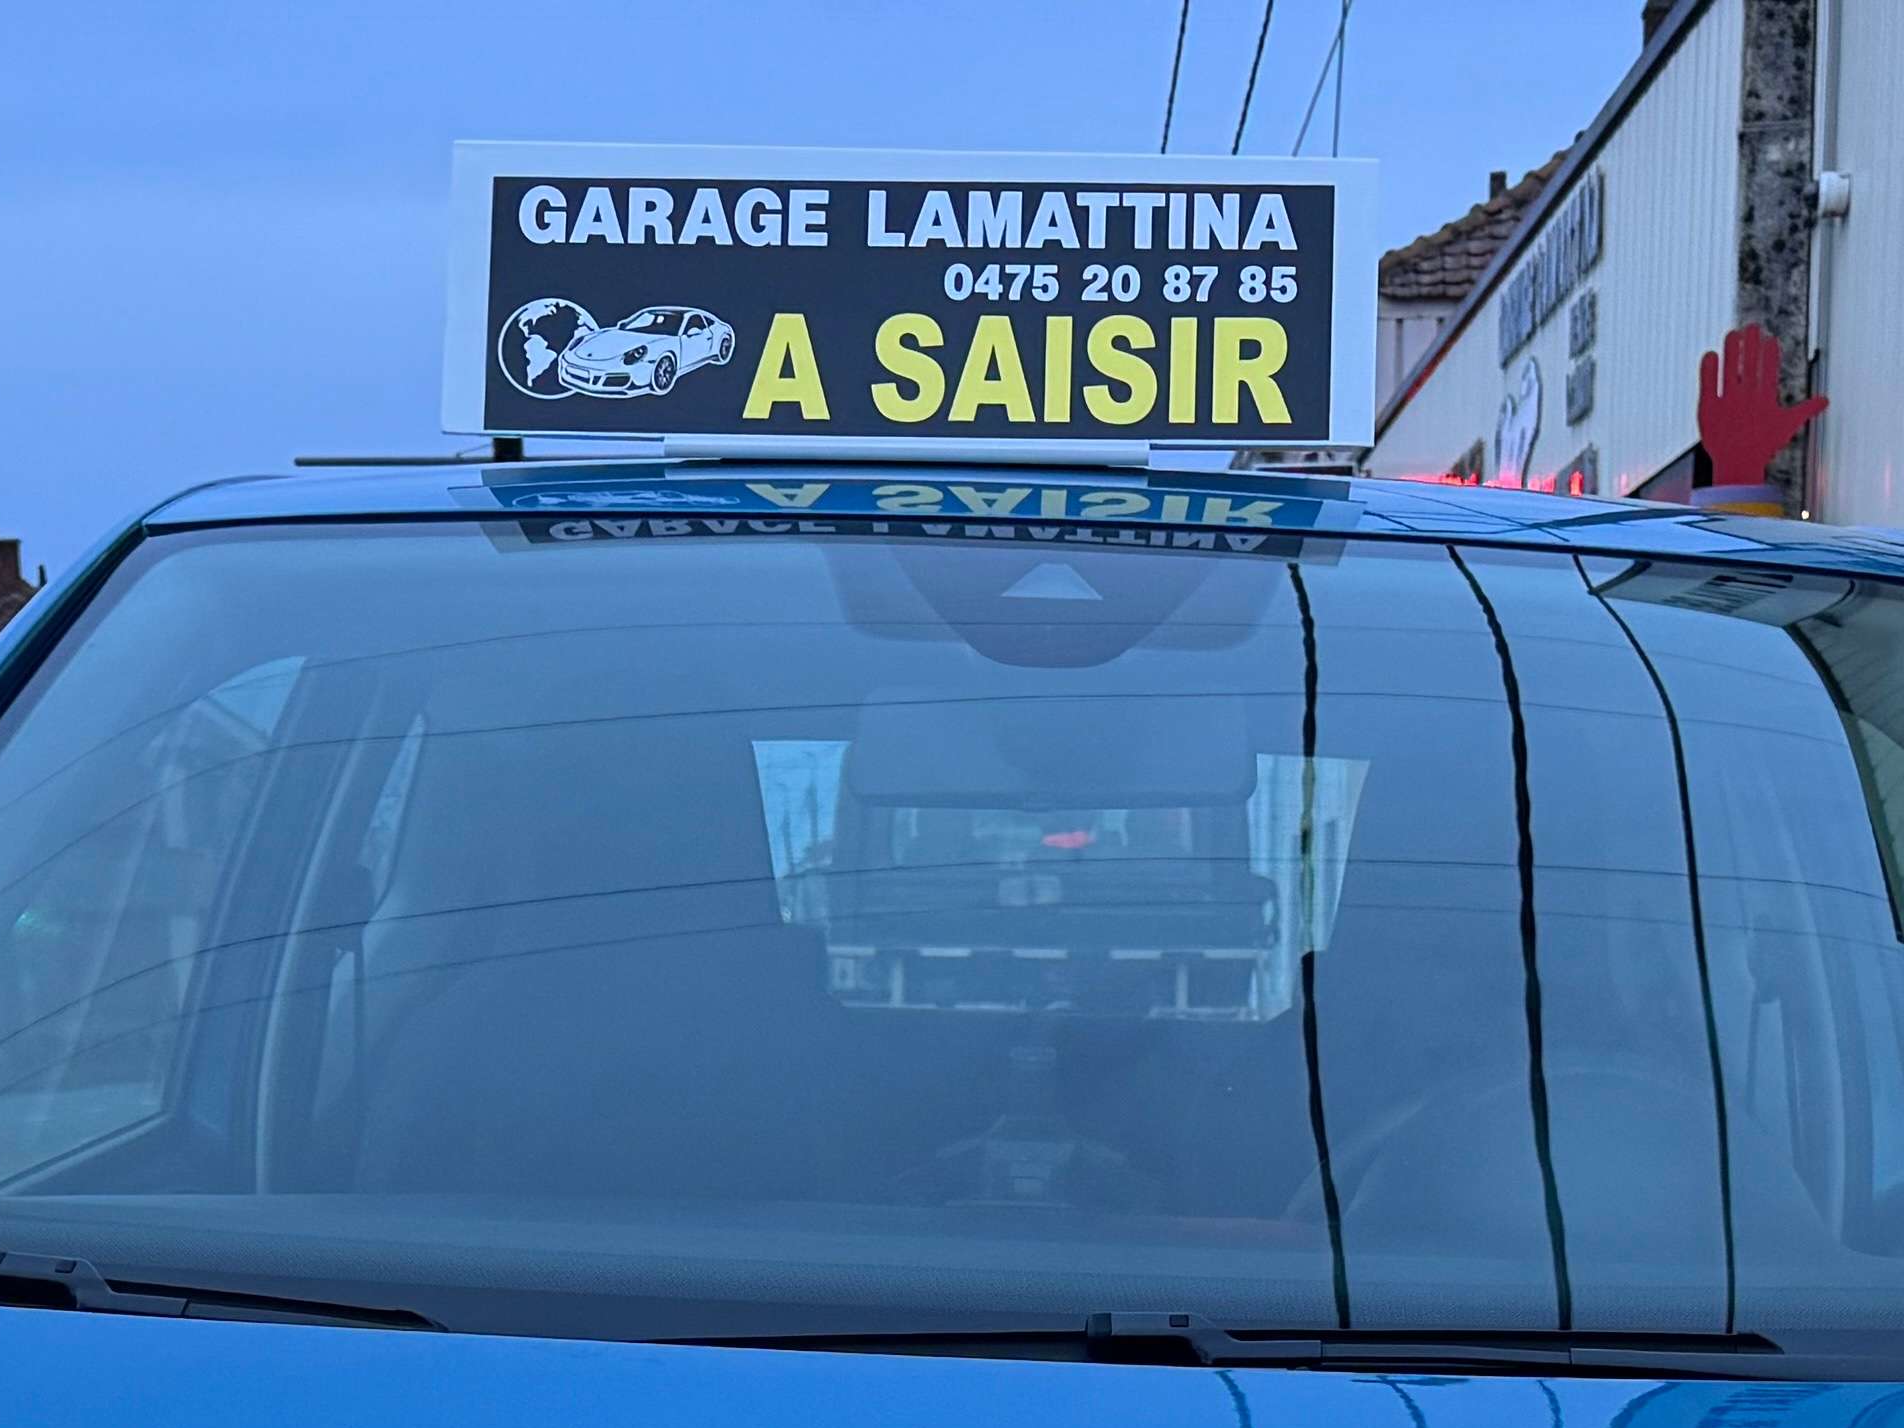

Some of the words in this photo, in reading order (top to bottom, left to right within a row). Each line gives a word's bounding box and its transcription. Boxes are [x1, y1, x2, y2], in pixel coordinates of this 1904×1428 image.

[519, 185, 829, 246] GARAGE
[867, 190, 1297, 250] LAMATTINA
[944, 263, 1059, 301] 0475
[1082, 264, 1140, 302] 20
[1163, 265, 1218, 302] 87
[1239, 266, 1297, 303] 85
[743, 313, 830, 420] A
[871, 313, 1292, 424] SAISIR
